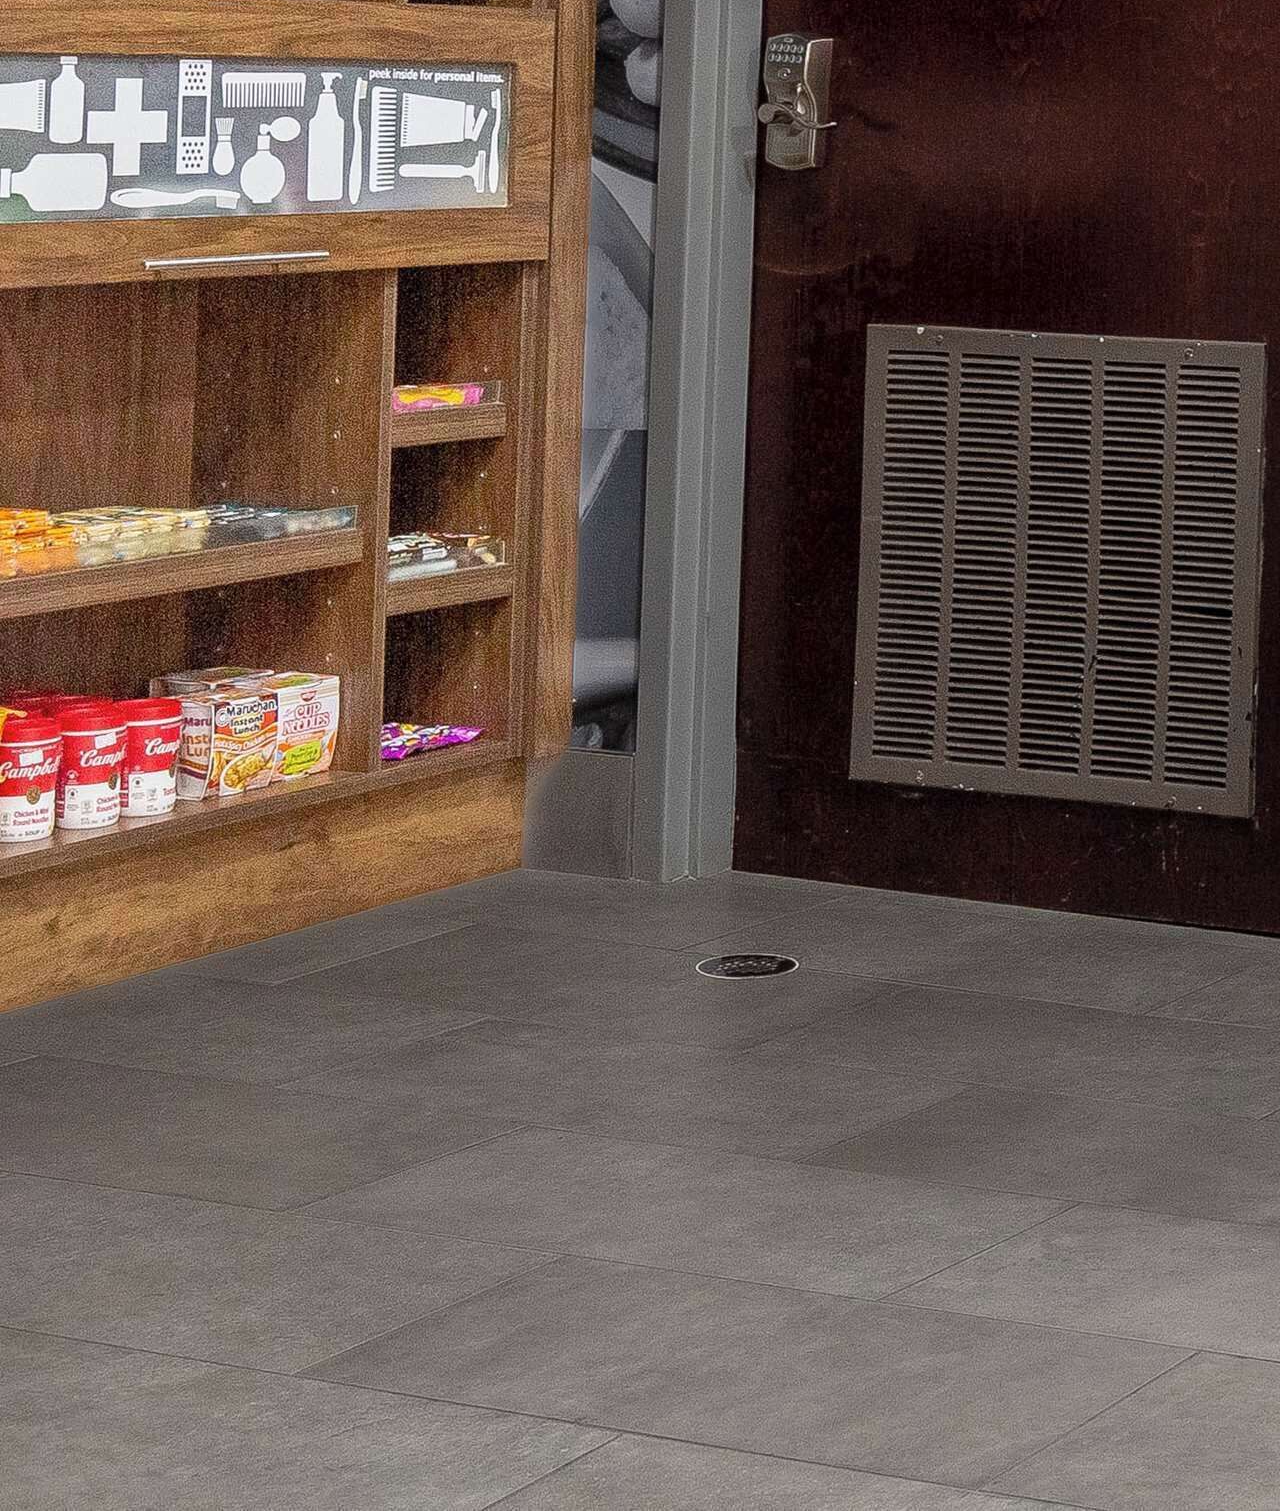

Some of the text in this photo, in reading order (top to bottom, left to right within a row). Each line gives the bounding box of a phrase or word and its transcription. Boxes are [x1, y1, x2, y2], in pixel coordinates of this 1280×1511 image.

[369, 68, 391, 81] peek
[392, 68, 418, 80] inside
[419, 68, 432, 81] for
[434, 71, 475, 84] personal
[227, 700, 276, 716] Maruchan
[295, 702, 321, 718] CUP
[185, 717, 211, 727] Maru
[231, 714, 263, 727] Instant
[283, 713, 330, 736] NOODLES
[234, 724, 260, 736] Lunch
[183, 734, 209, 745] Inst
